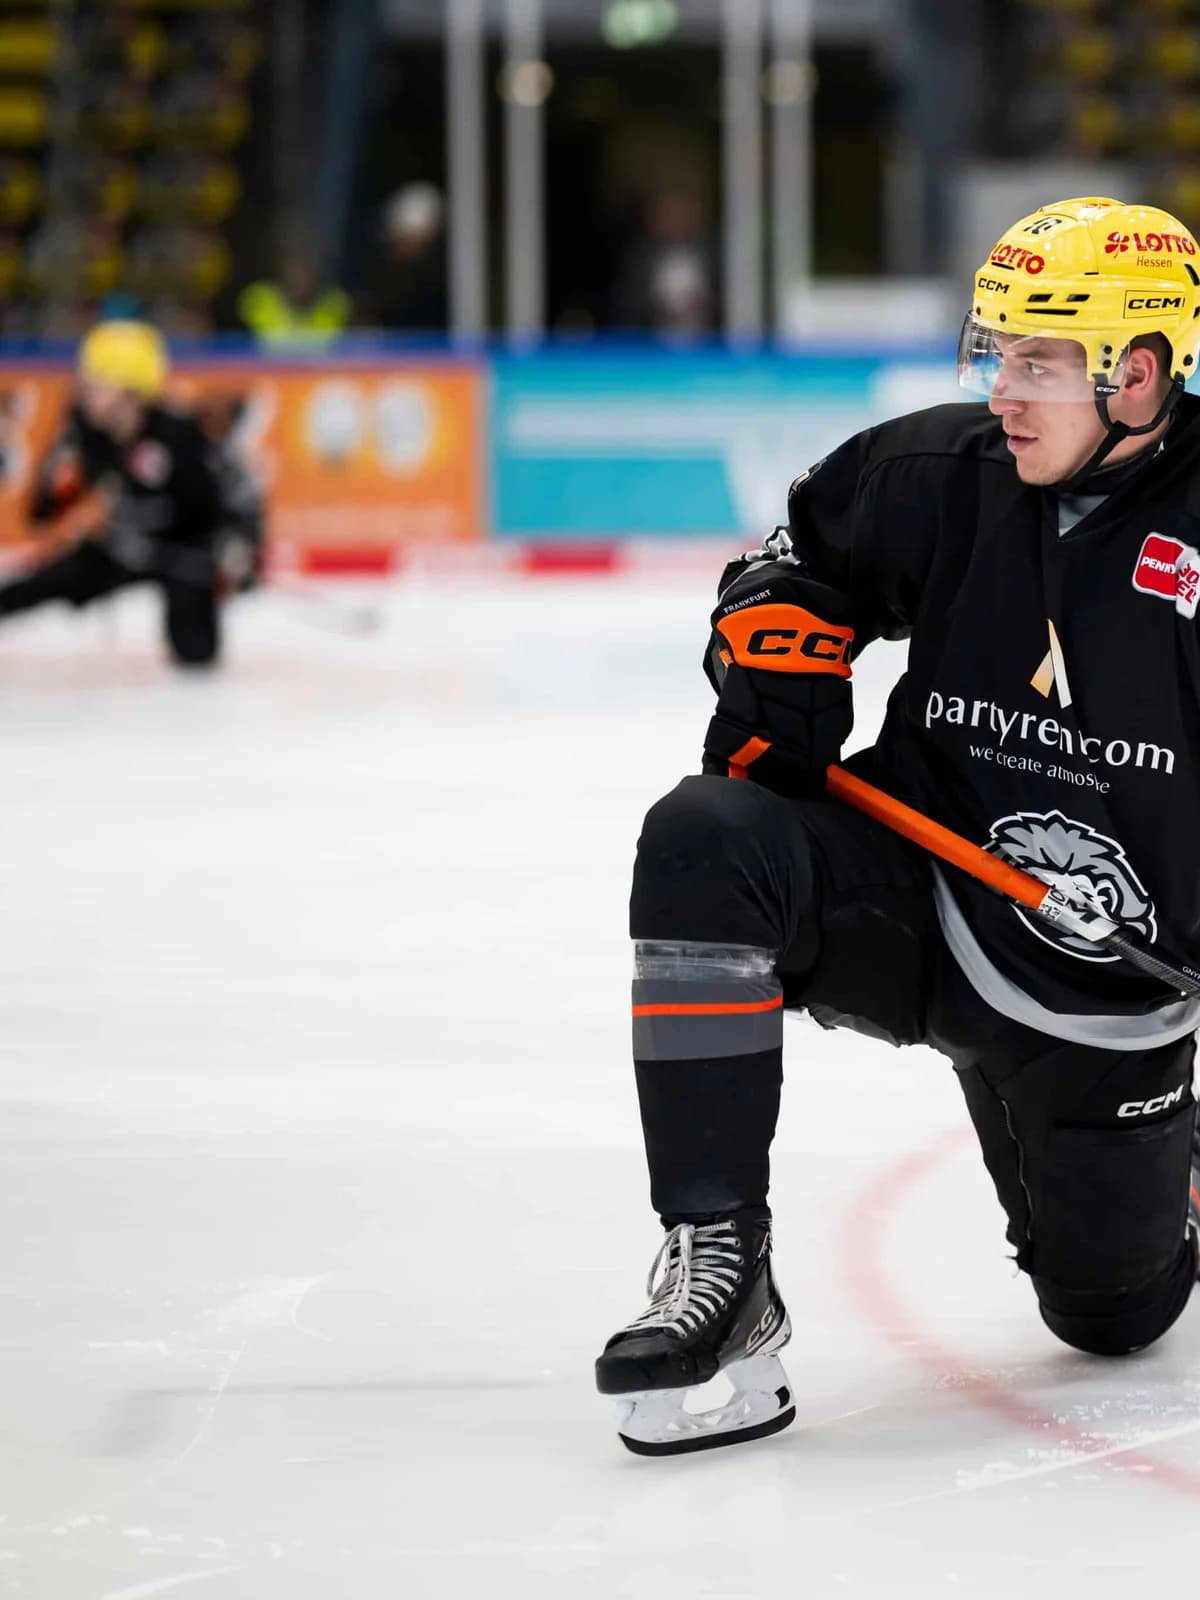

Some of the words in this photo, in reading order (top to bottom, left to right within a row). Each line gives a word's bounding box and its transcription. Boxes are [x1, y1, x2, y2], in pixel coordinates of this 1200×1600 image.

[1132, 232, 1196, 256] LOTTO
[990, 243, 1045, 276] LOTTO
[1136, 256, 1172, 268] Hessen
[978, 277, 1010, 294] CCM
[1128, 297, 1181, 310] CCM
[723, 589, 772, 614] FRANKFURT
[746, 628, 851, 667] CC
[969, 745, 994, 761] we
[996, 749, 1042, 774] create
[1117, 1084, 1184, 1117] CCM
